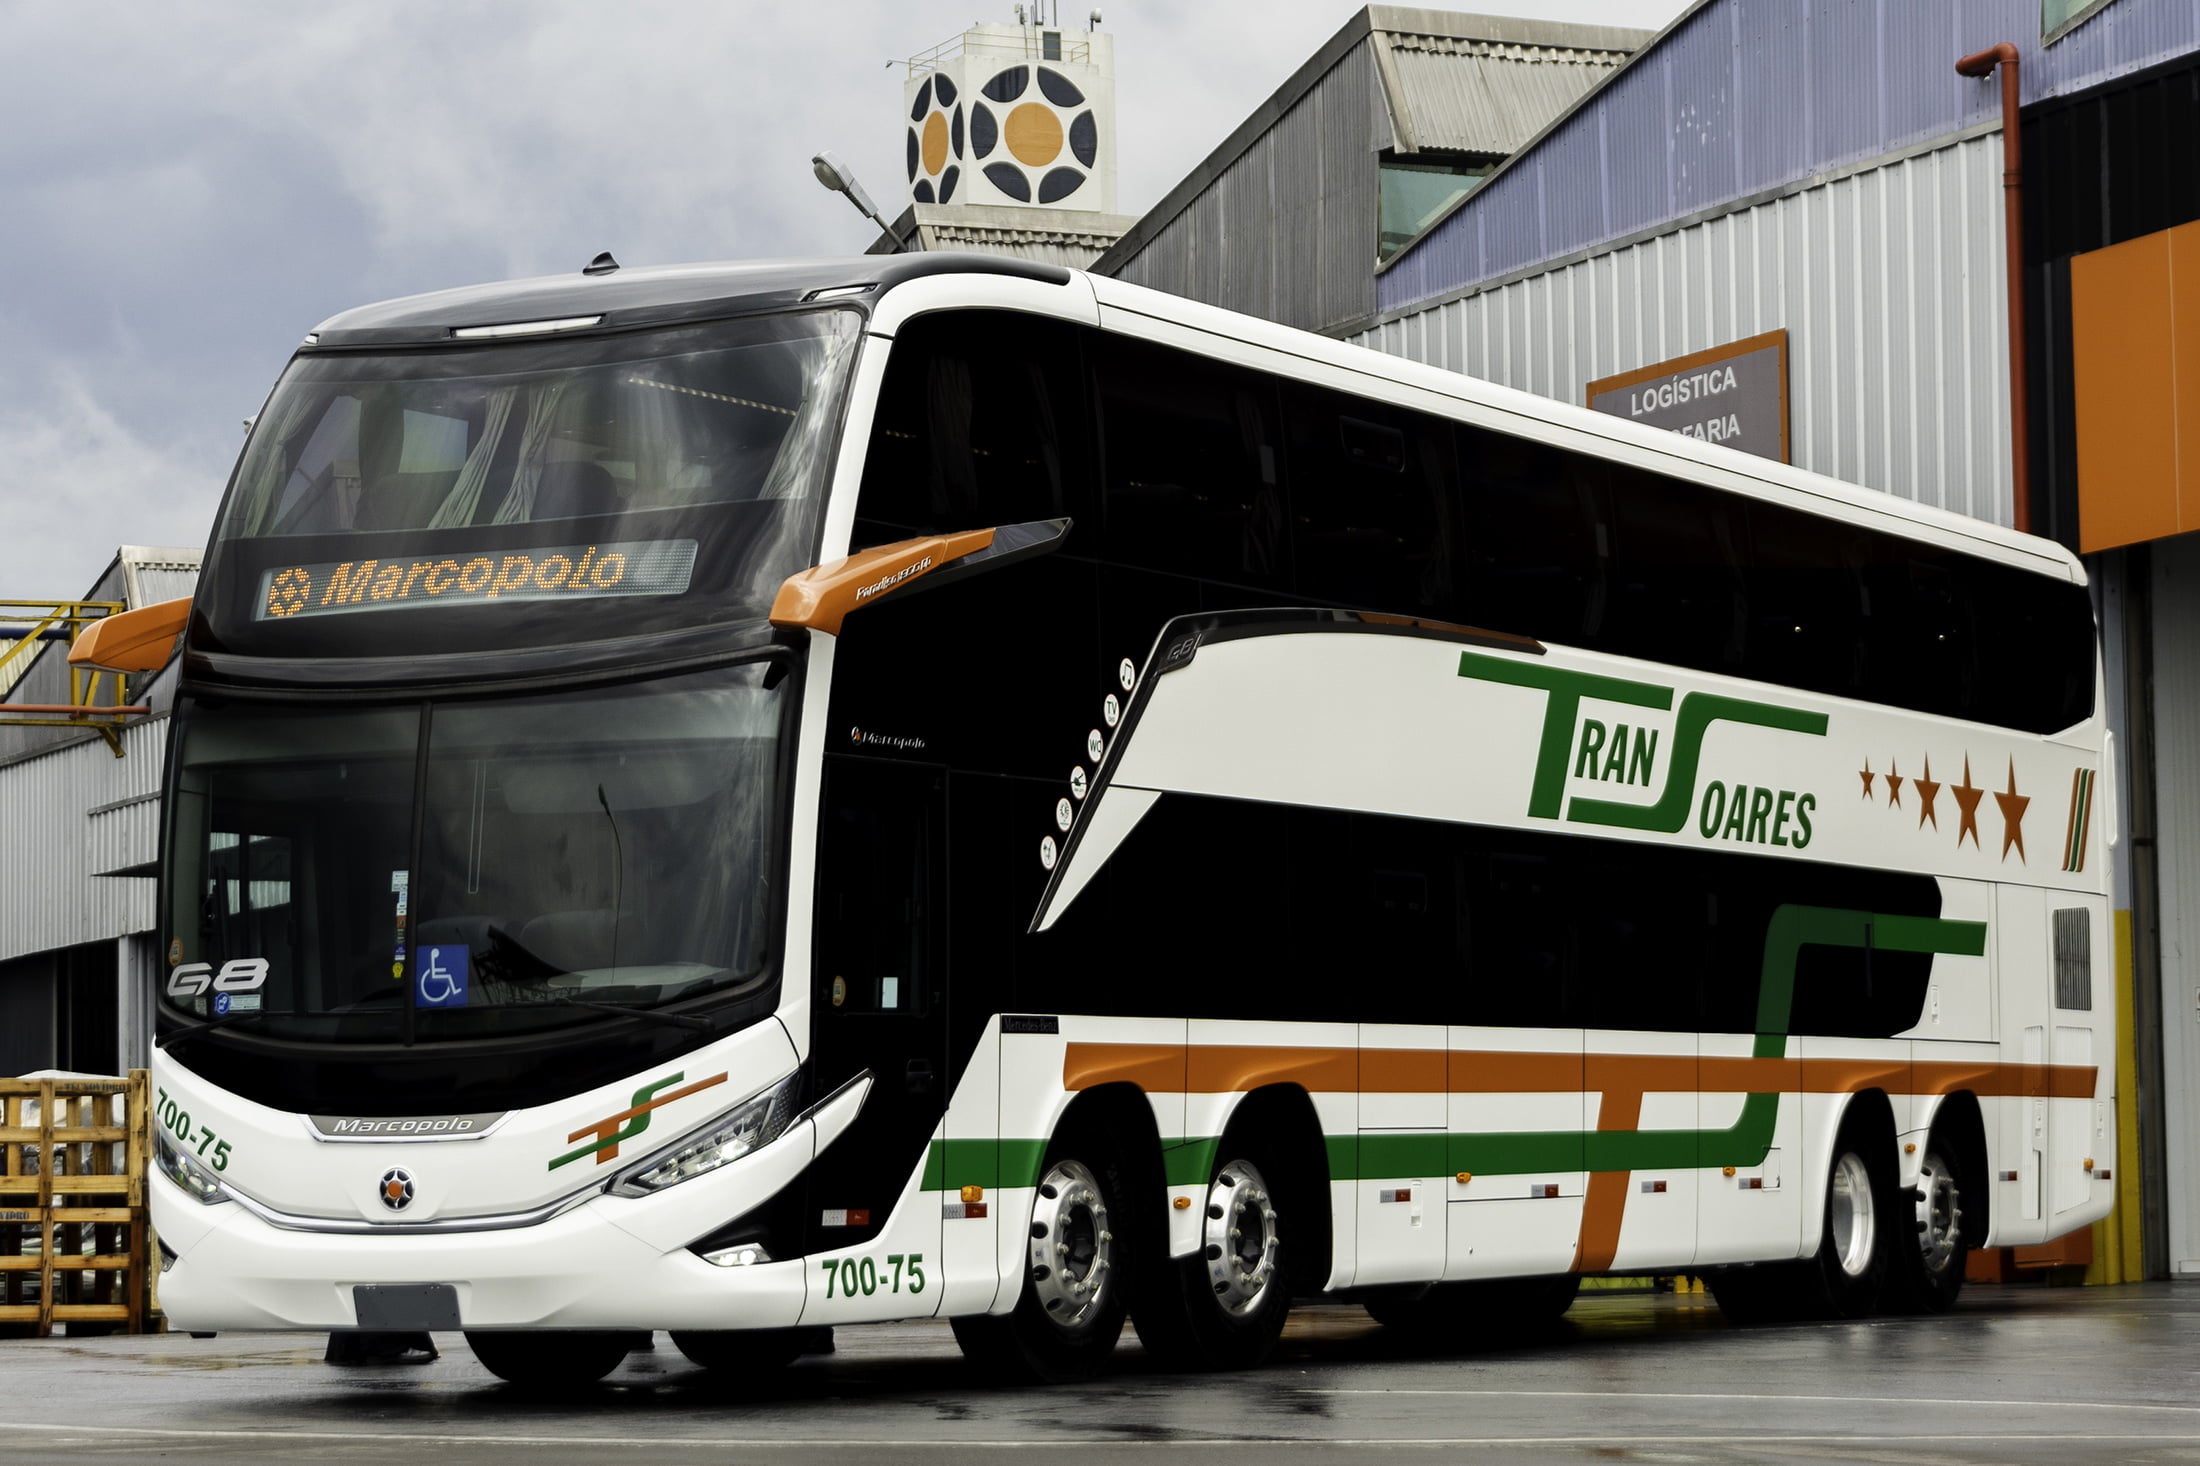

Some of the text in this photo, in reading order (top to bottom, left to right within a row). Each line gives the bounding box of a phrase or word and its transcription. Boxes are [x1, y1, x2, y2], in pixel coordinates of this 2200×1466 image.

[1631, 366, 1737, 416] LOGÍSTICA
[321, 546, 626, 599] Marcopolo
[1106, 701, 1117, 715] TV
[1089, 739, 1101, 753] WC
[167, 958, 270, 997] G8
[157, 1086, 232, 1172] 700-75
[333, 1117, 473, 1134] Marcopolo
[822, 1253, 926, 1299] 700-75
